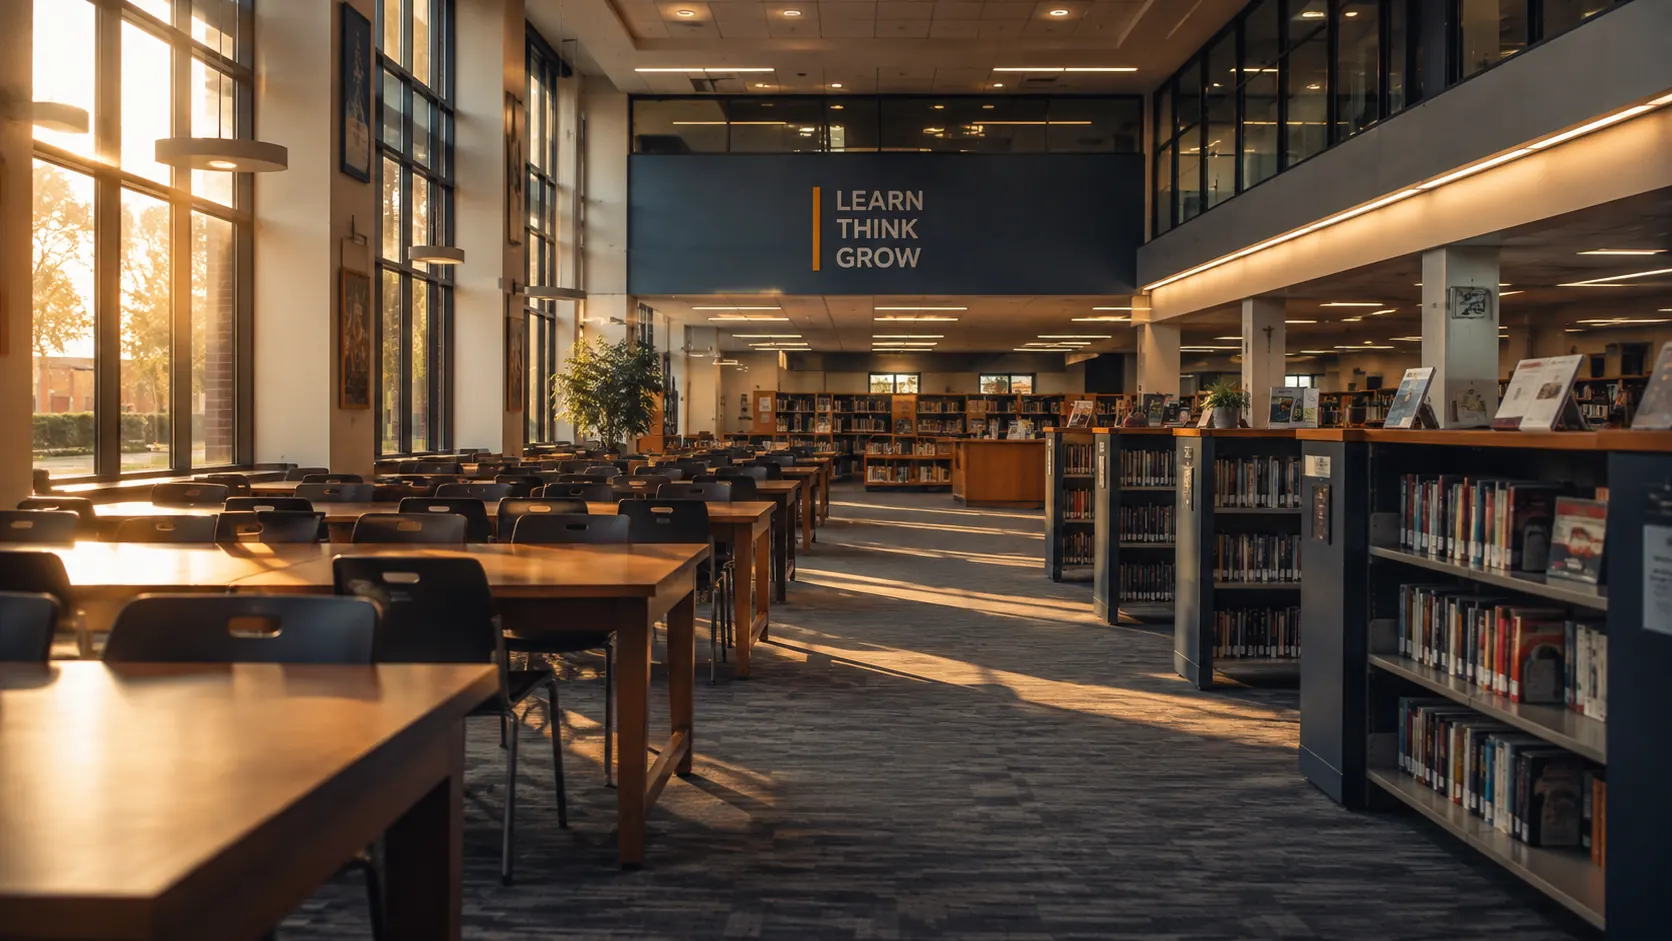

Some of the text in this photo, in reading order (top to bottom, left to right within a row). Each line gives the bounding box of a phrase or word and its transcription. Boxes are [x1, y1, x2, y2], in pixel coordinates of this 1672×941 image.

[836, 190, 923, 211] LEARN
[836, 218, 919, 239] THINK
[836, 246, 921, 268] GROW
